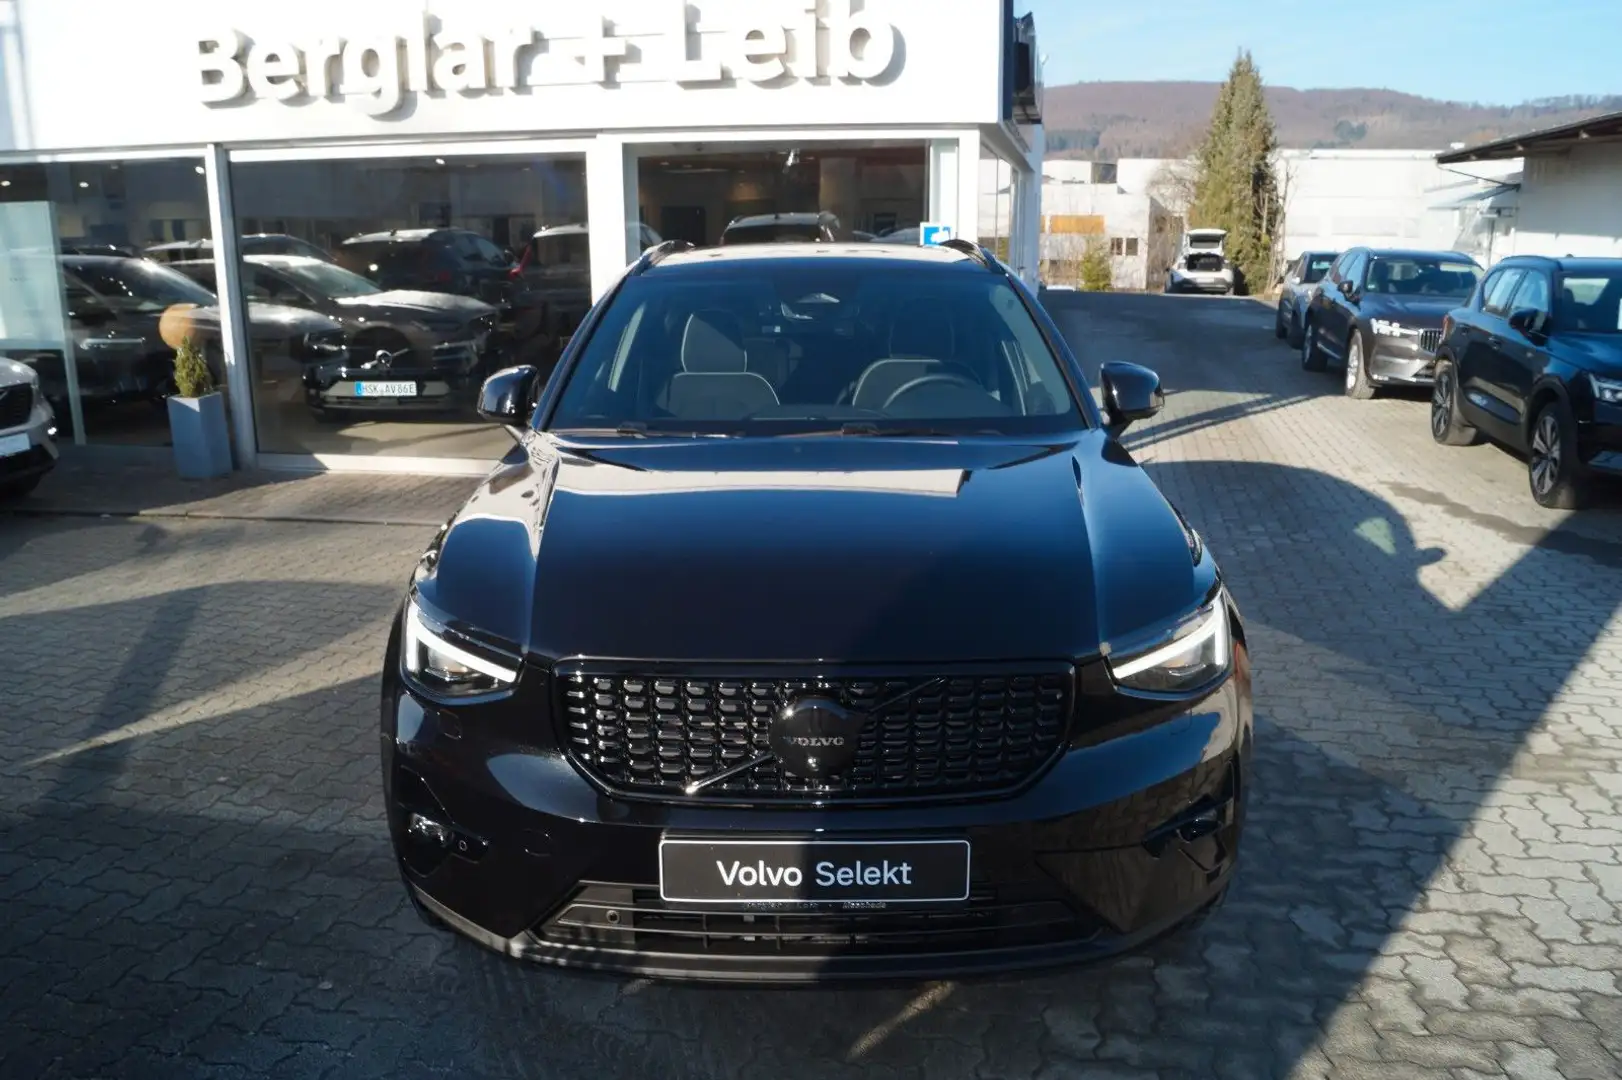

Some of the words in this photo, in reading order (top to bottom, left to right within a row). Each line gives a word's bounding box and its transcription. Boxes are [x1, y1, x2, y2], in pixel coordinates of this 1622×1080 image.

[197, 8, 542, 120] Berglar
[671, 0, 903, 87] Leib
[782, 736, 845, 747] VOLVO
[716, 860, 803, 887] Volvo
[815, 860, 912, 887] Selekt
